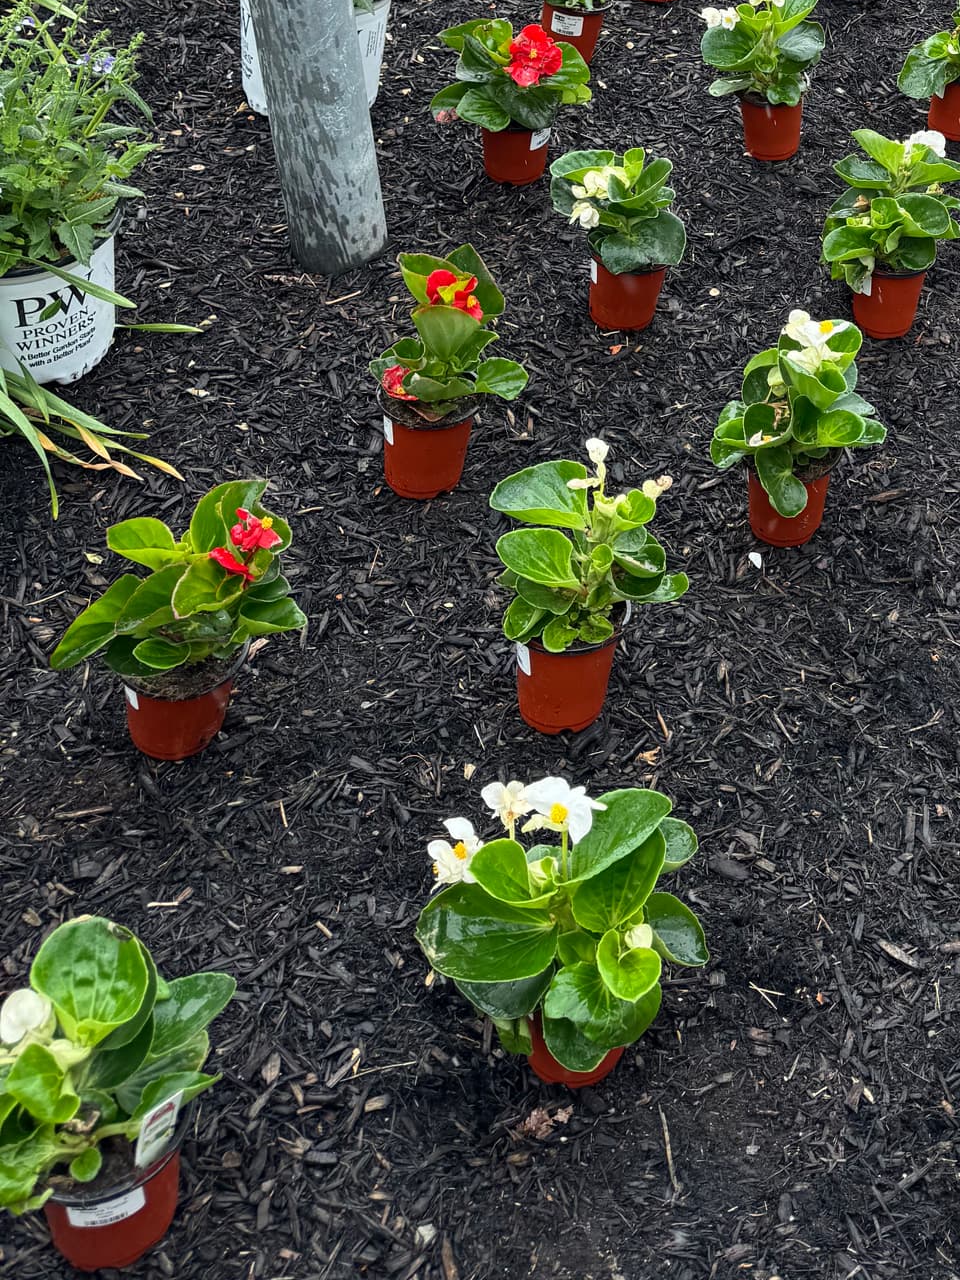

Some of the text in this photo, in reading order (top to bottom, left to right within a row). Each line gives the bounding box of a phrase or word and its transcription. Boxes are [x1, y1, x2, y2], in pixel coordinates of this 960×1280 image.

[23, 305, 90, 340] PROVEN
[28, 350, 51, 361] Better
[53, 339, 78, 354] Garden
[29, 359, 45, 368] with
[53, 348, 74, 362] Better
